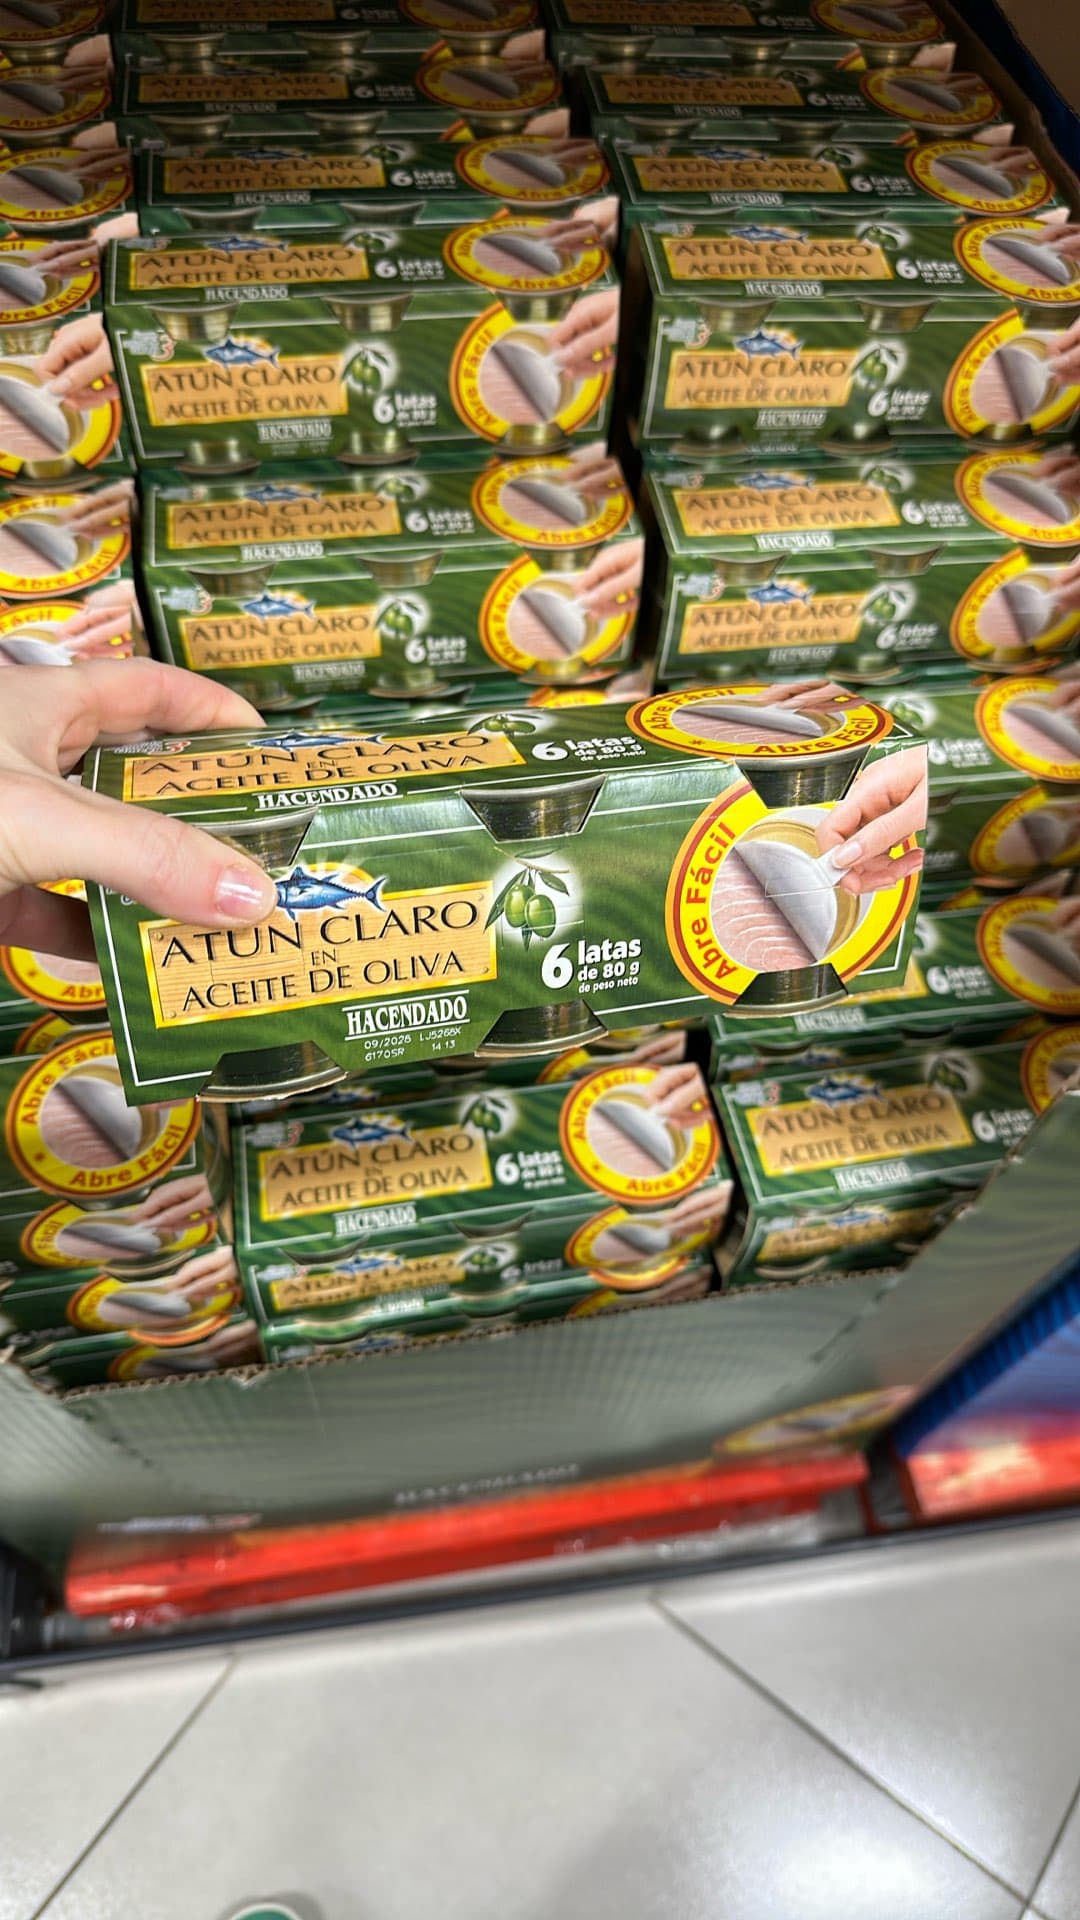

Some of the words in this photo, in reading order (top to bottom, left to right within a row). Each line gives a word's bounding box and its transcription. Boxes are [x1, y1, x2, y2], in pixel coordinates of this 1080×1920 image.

[390, 170, 413, 187] 6
[851, 175, 872, 193] 6
[245, 248, 355, 268] CLARO
[770, 241, 872, 257] CLARO
[272, 267, 346, 281] OLIVA
[374, 259, 398, 280] 6
[896, 258, 919, 280] 6
[916, 259, 960, 273] latas
[463, 328, 495, 380] Fácil
[760, 357, 848, 377] CLARO
[152, 368, 233, 394] ATÚN
[242, 364, 337, 388] CLARO
[166, 400, 231, 420] ACEITE
[236, 397, 265, 415] DE
[267, 393, 329, 412] OLIVA
[373, 395, 396, 424] 6
[464, 387, 498, 428] Abre
[867, 389, 889, 417] 6
[279, 499, 387, 518] CLARO
[778, 486, 878, 507] CLARO
[405, 511, 429, 533] 6
[902, 501, 926, 525] 6
[187, 526, 262, 544] ACEITE
[270, 523, 300, 537] DE
[306, 518, 379, 534] OLIVA
[770, 602, 861, 624] CLARO
[191, 619, 270, 643] ATÚN
[278, 614, 370, 637] CLARO
[876, 626, 899, 650] 6
[203, 645, 267, 665] ACEITE
[272, 643, 301, 660] DE
[303, 639, 364, 657] OLIVA
[405, 637, 427, 664] 6
[649, 704, 675, 732] Abre
[671, 688, 737, 706] Fácil
[316, 734, 490, 760] CLARO
[564, 736, 638, 752] latas
[752, 736, 834, 755] Abre
[834, 717, 875, 744] Fácil
[531, 742, 569, 761] 6
[575, 748, 598, 757] de
[600, 744, 627, 755] 80
[155, 771, 293, 795] ACEITE
[304, 766, 355, 782] DE
[366, 754, 487, 776] OLIVA
[307, 760, 336, 769] EN
[257, 783, 398, 809] HACENDADO
[686, 821, 739, 905] Fácil
[320, 899, 480, 946] CLARO
[311, 948, 338, 968] EN
[578, 938, 642, 966] latas
[690, 917, 739, 980] Abre
[541, 942, 573, 989] 6
[577, 965, 599, 982] de
[602, 961, 626, 979] 80
[629, 961, 640, 976] g
[62, 984, 104, 998] Abr
[182, 972, 298, 1012] ACEITE
[308, 964, 353, 995] DE
[362, 950, 467, 986] OLIVA
[578, 982, 591, 994] de
[592, 979, 615, 994] peso
[617, 975, 639, 988] neto
[926, 965, 950, 995] 6
[346, 996, 468, 1036] HACENDADO
[21, 1070, 52, 1125] Abre
[572, 1092, 595, 1142] Abre
[762, 1105, 845, 1137] ATÚN
[850, 1093, 946, 1122] CLARO
[971, 1111, 998, 1143] 6
[69, 1166, 134, 1189] Abre
[138, 1125, 185, 1170] Fácil
[270, 1151, 362, 1180] ATÚN
[370, 1135, 475, 1165] CLARO
[780, 1140, 848, 1166] ACEITE
[851, 1134, 881, 1153] DE
[884, 1123, 950, 1146] OLIVA
[495, 1153, 520, 1185] 6
[517, 1151, 562, 1168] latas
[280, 1183, 358, 1210] ACEITE
[363, 1176, 395, 1196] DE
[400, 1166, 469, 1189] OLIVA
[626, 1175, 675, 1193] Abre
[335, 1205, 417, 1235] HACENDADO
